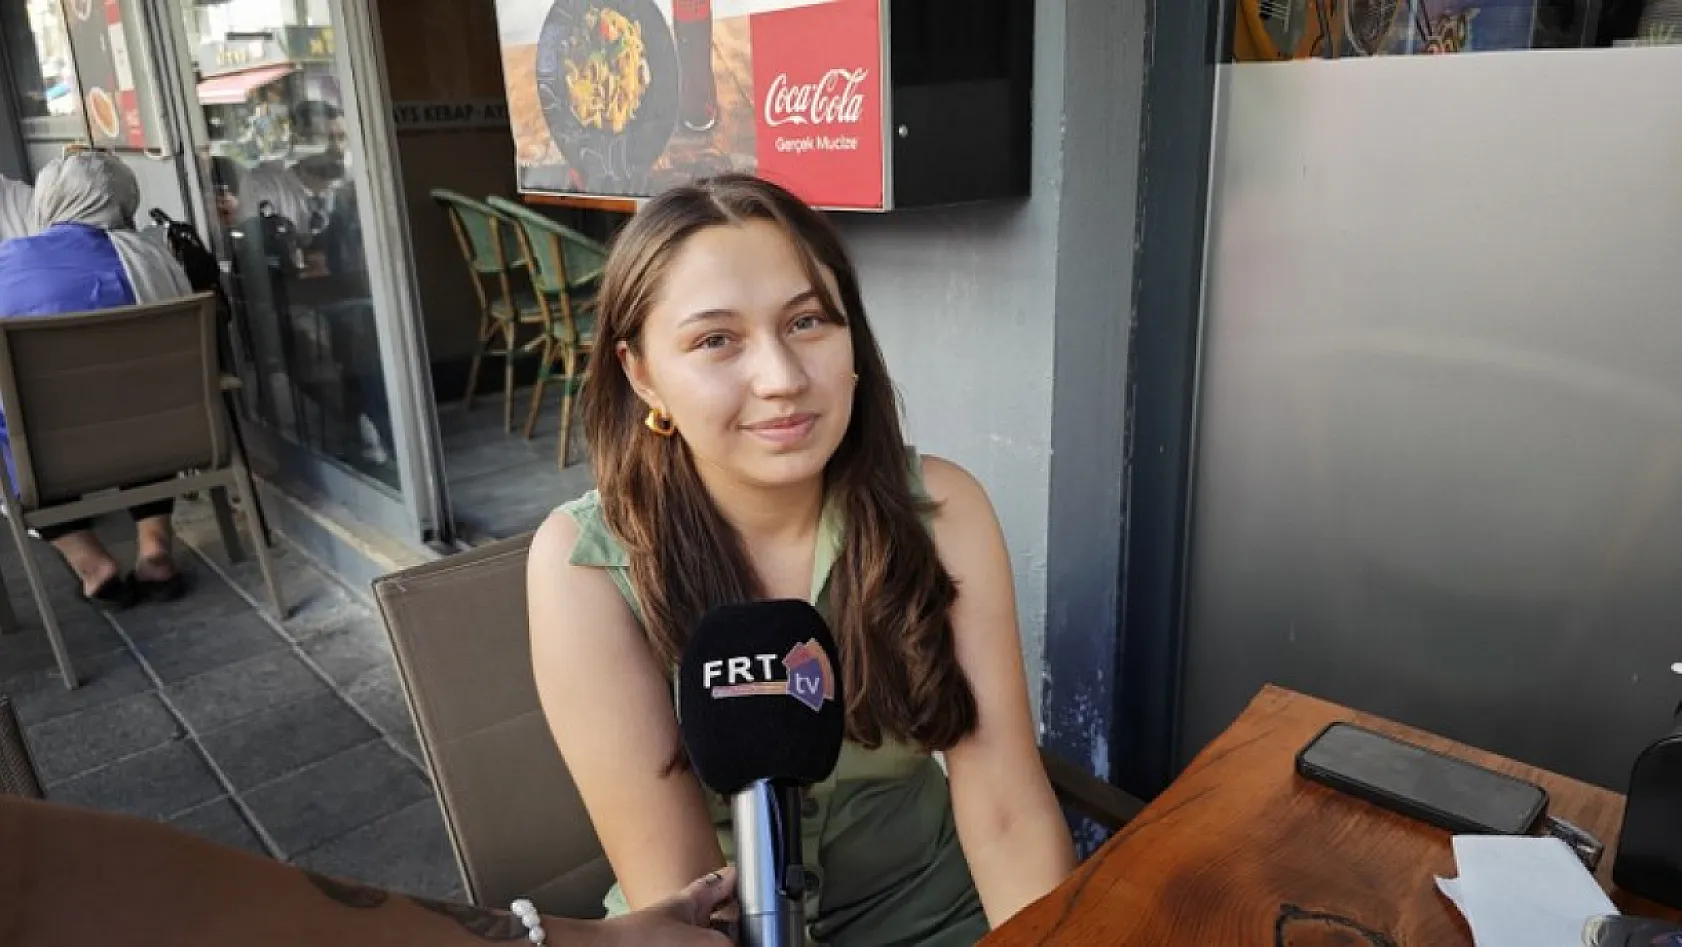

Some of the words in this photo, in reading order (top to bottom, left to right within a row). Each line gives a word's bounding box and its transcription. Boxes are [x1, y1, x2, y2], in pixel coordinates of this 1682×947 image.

[764, 67, 869, 126] Coca-Cola
[775, 136, 813, 156] Gerçek
[815, 135, 858, 151] Mucize
[702, 653, 778, 689] FRT
[795, 672, 820, 694] tv
